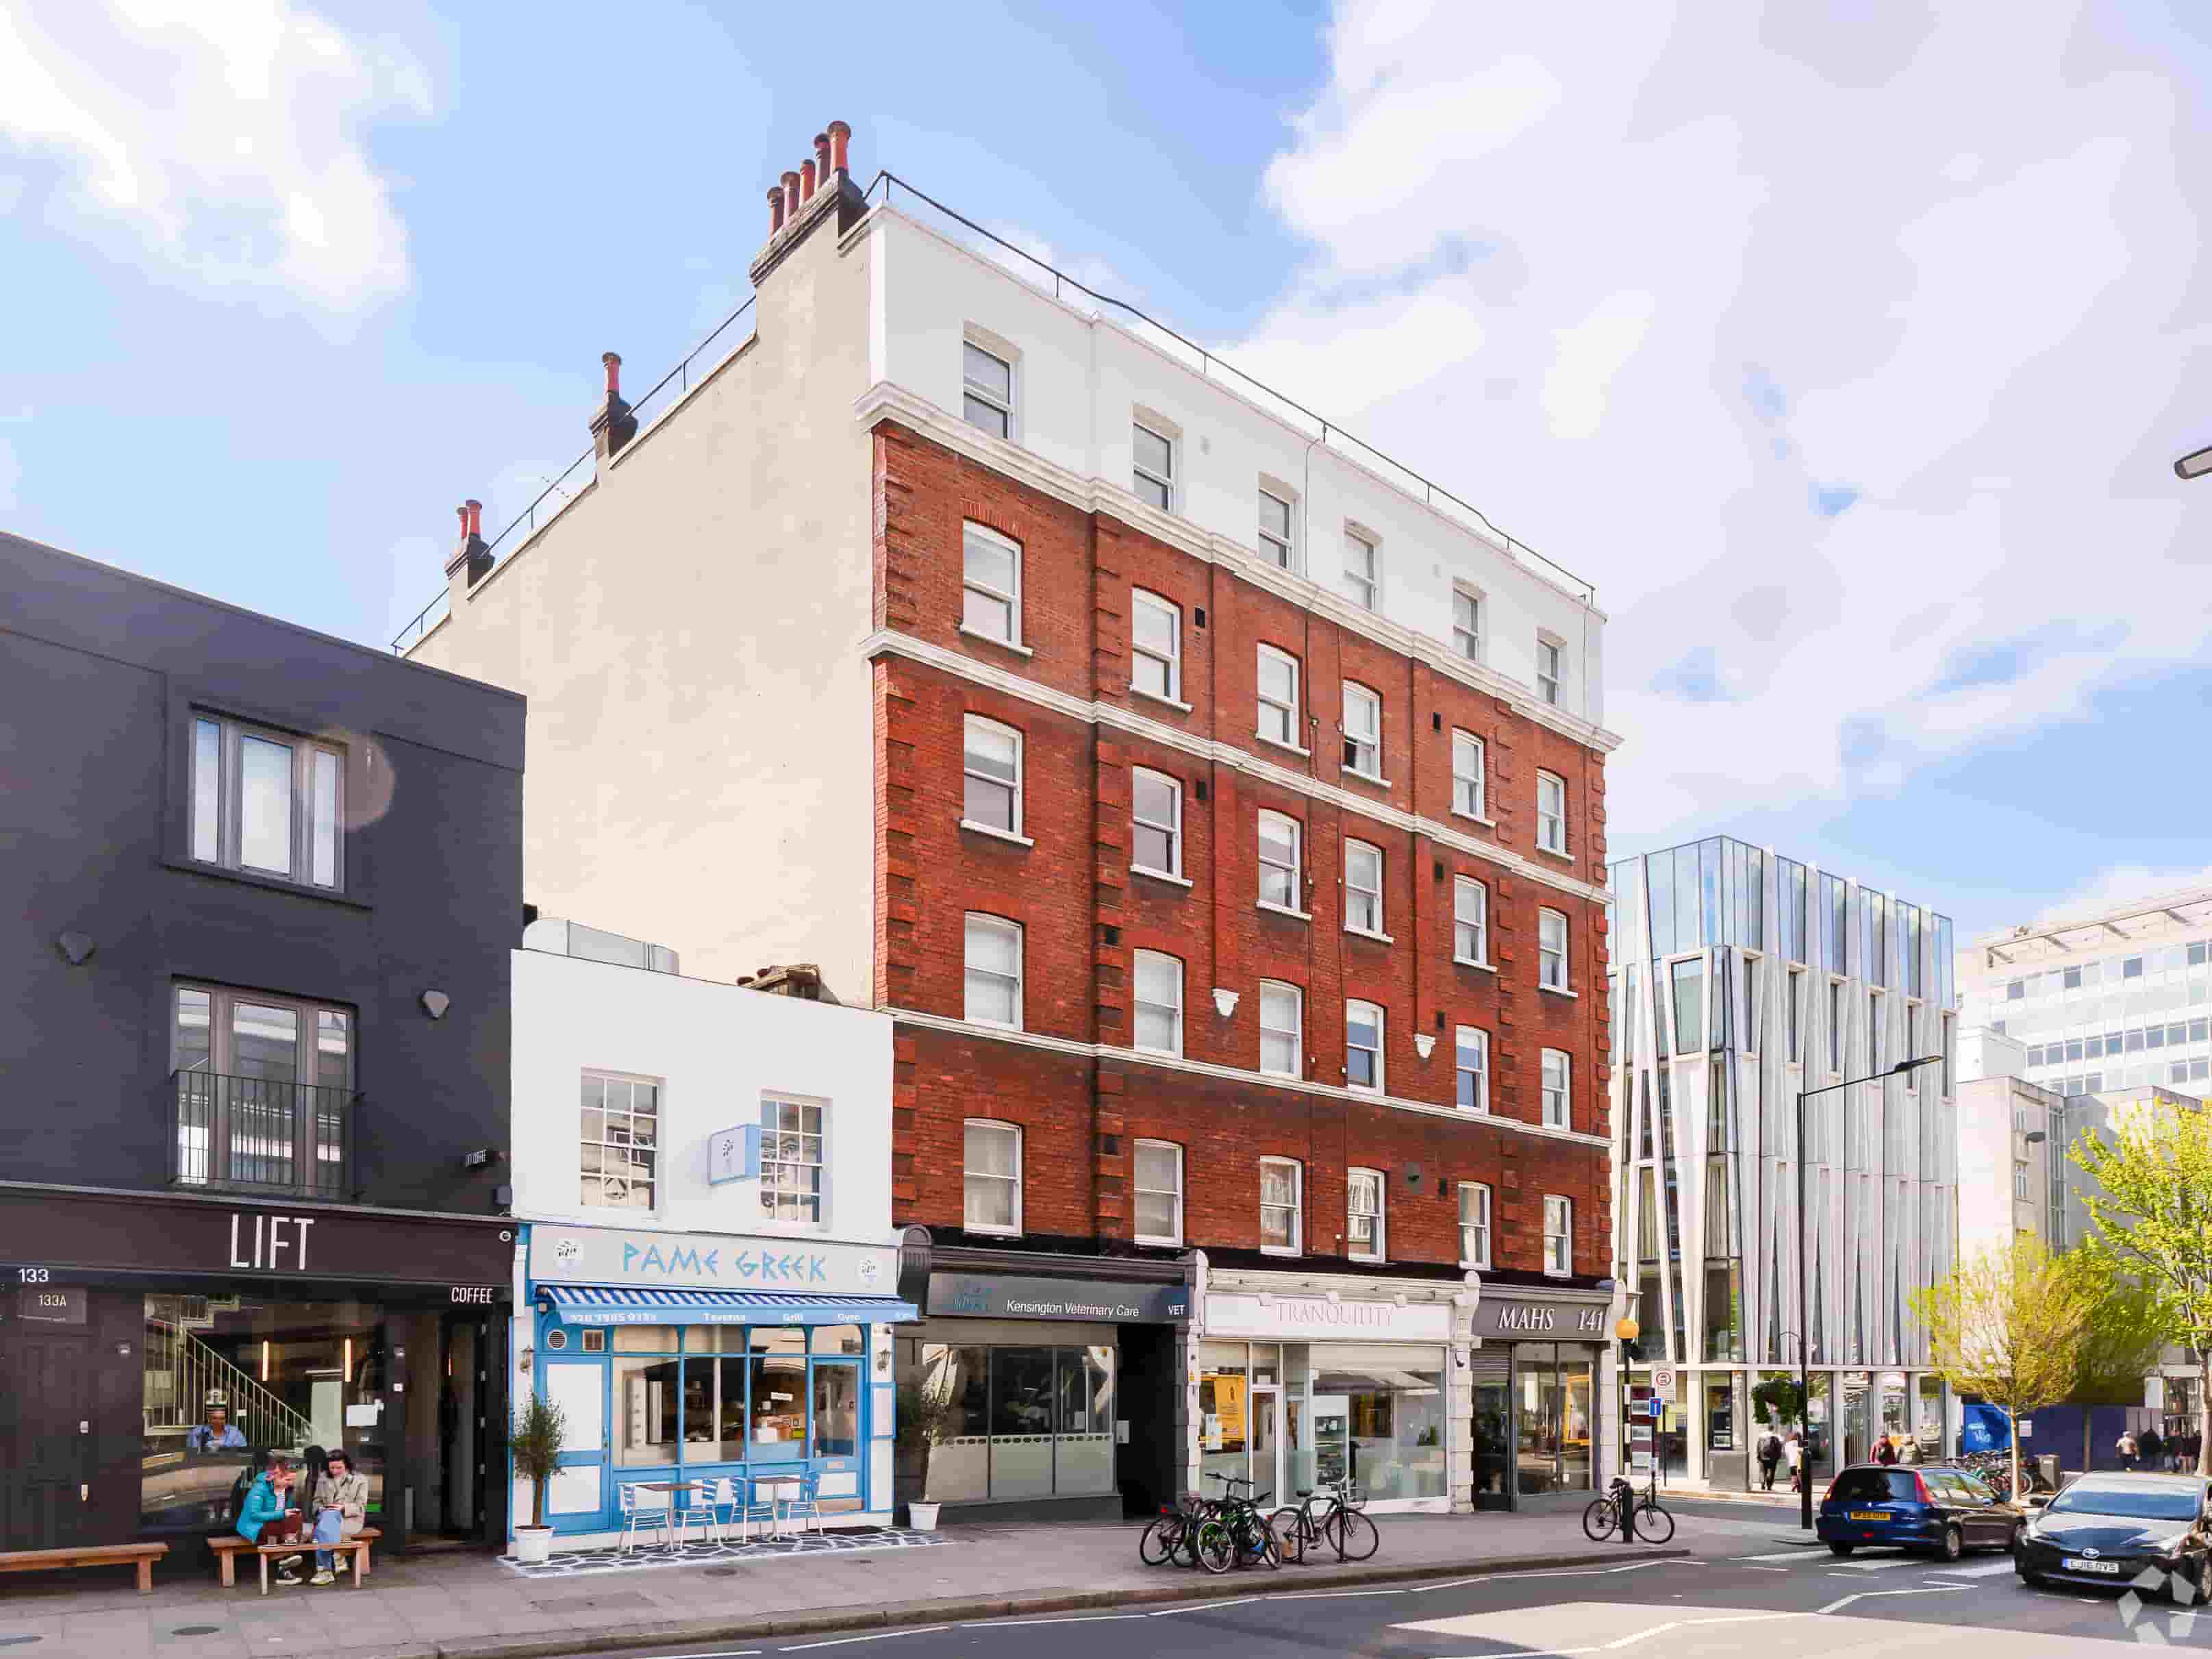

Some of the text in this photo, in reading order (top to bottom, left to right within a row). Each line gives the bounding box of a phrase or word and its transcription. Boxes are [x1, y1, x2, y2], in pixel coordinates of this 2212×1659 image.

[230, 1213, 314, 1271] LIFT
[623, 1240, 718, 1277] PAME
[733, 1249, 828, 1284] GREEK
[18, 1268, 49, 1283] 133
[38, 1294, 66, 1307] 133A
[451, 1286, 493, 1304] COFFEE
[1006, 1299, 1062, 1316] Kensington
[1064, 1301, 1114, 1319] Veterinary
[1116, 1304, 1140, 1317] Care
[1167, 1305, 1185, 1316] VET
[1497, 1306, 1556, 1331] MAHS
[1577, 1309, 1603, 1332] 141
